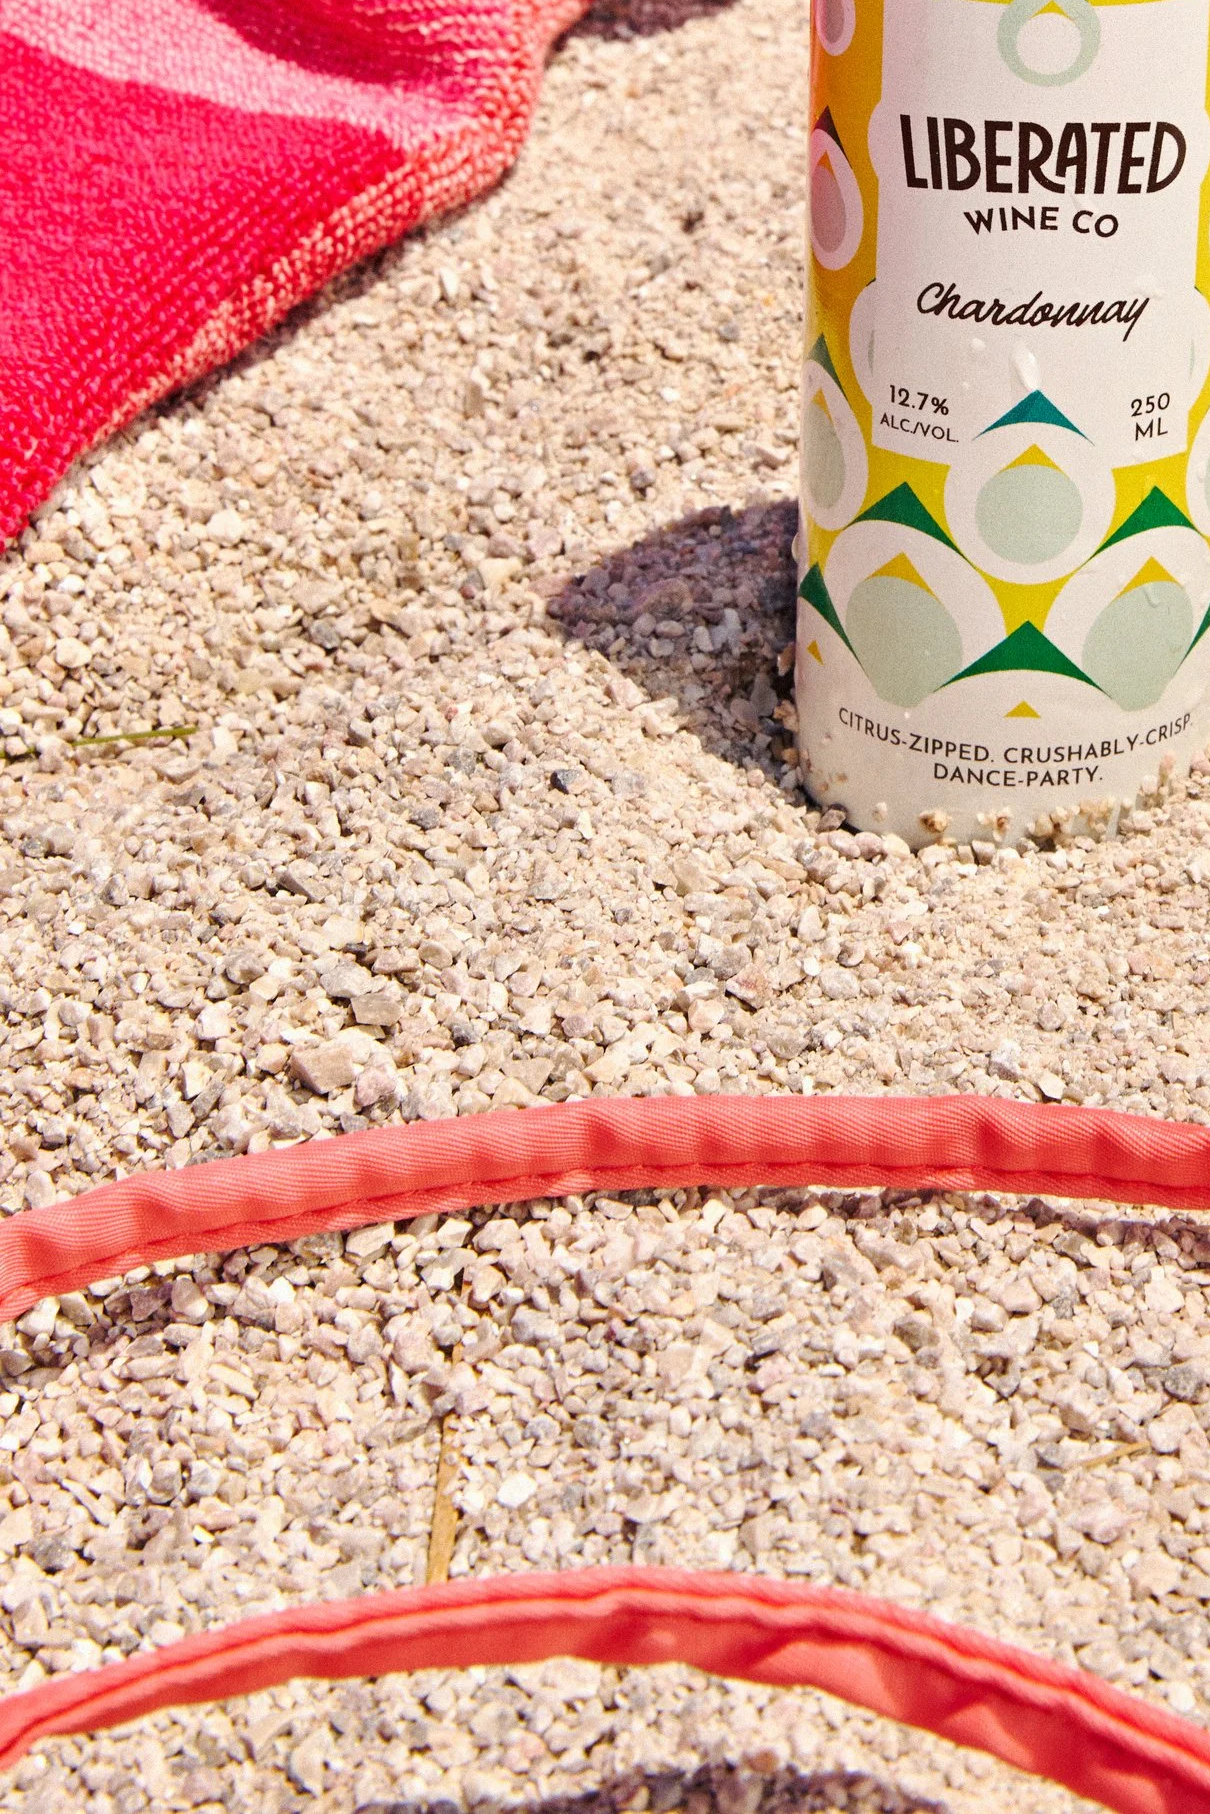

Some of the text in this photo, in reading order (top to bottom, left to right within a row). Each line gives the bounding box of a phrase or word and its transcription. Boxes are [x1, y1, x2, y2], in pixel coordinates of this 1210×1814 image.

[899, 113, 1187, 195] LIBERATED
[962, 205, 1119, 239] WINE CO
[916, 281, 1150, 343] Chardonnay
[888, 384, 950, 417] 12.7%
[1130, 392, 1172, 418] 250
[1133, 416, 1170, 442] ML
[838, 707, 995, 763] CITRUS-ZIPPED.
[933, 762, 1104, 787] DANCE-PARTY.
